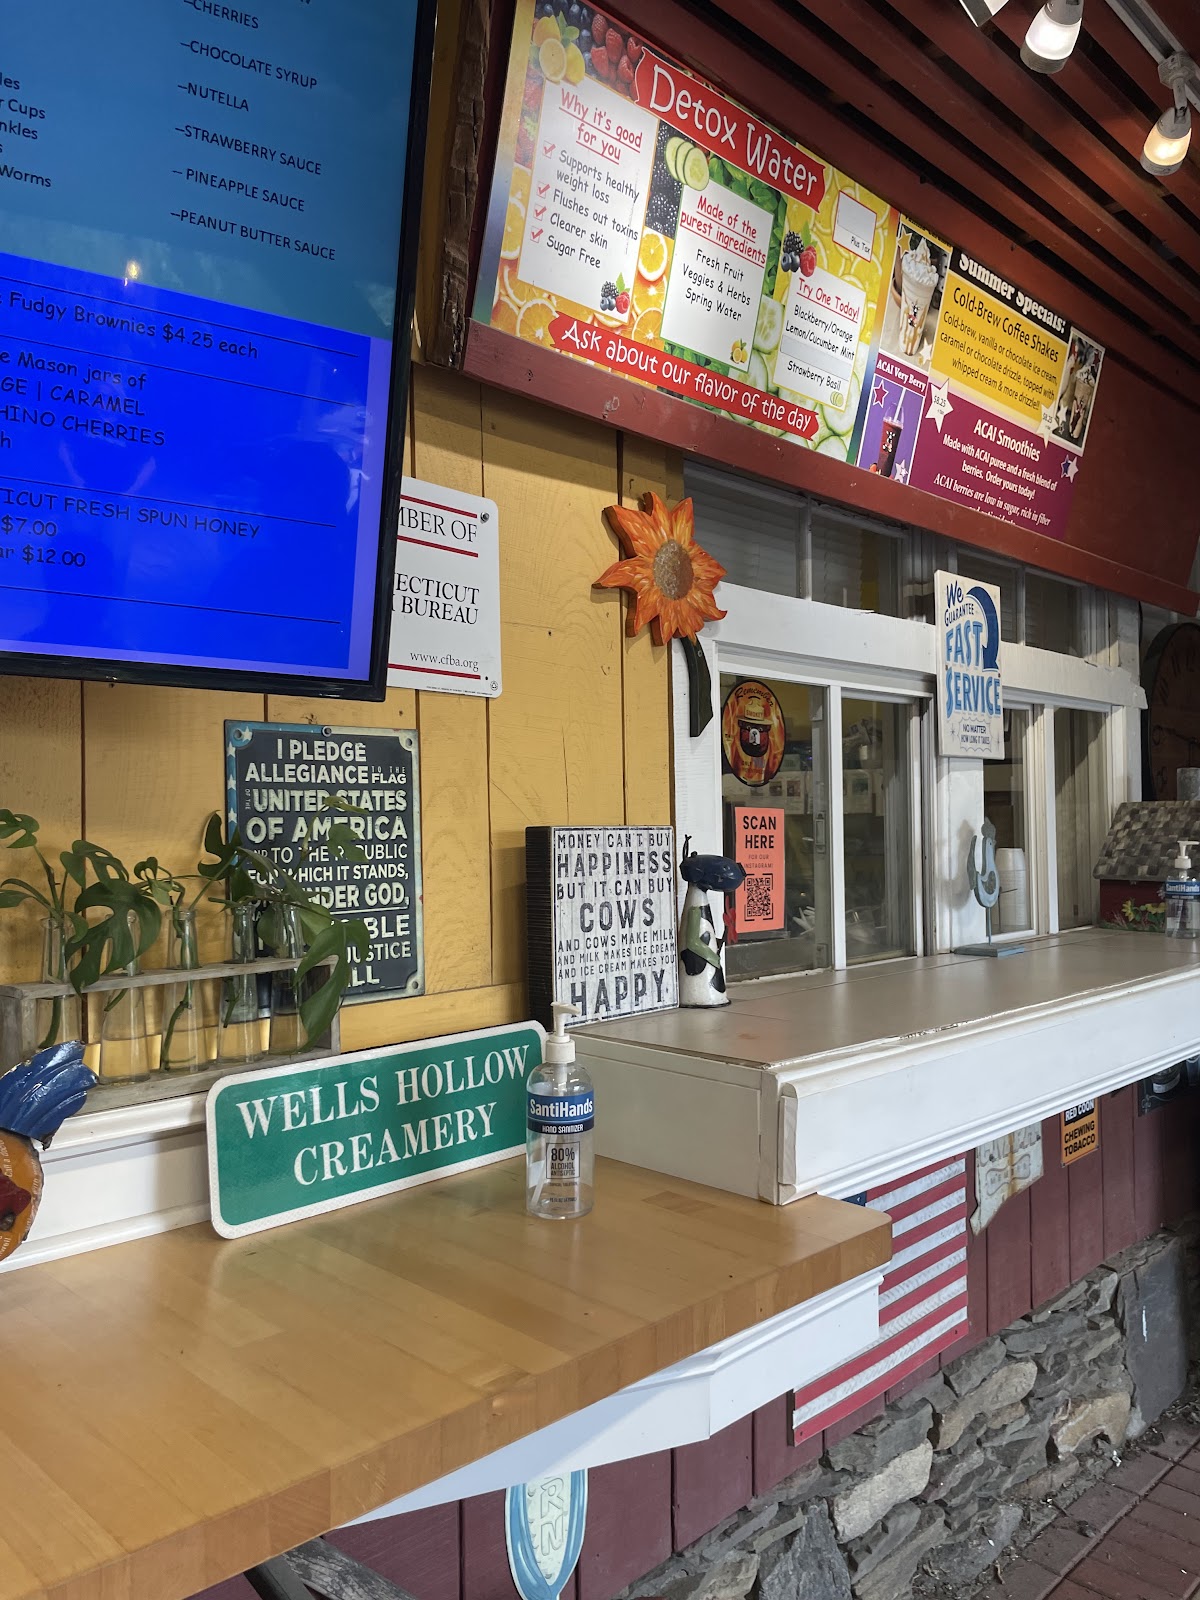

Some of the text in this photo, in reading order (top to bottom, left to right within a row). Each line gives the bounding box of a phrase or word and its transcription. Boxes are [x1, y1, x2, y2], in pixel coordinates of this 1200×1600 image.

[276, 67, 317, 89] SYRUP
[8, 99, 46, 120] Cups
[561, 88, 643, 149] Why it's good
[577, 123, 621, 160] for you
[649, 63, 817, 196] Detox Water
[280, 152, 322, 175] SAUCE
[559, 150, 639, 203] Supports healthy
[186, 168, 304, 212] PINEAPPLE SAUCE
[556, 169, 610, 204] weight loss
[553, 188, 638, 241] Flushes out toxins
[697, 195, 757, 240] Made the
[240, 225, 335, 260] BUTTER SAUCE
[550, 212, 608, 249] Clearer skin
[680, 210, 766, 265] purest ingredients
[546, 235, 601, 269] Sugar Free
[696, 248, 744, 282] Fresh Fruit
[682, 262, 751, 306] Veggies Herbs
[798, 277, 860, 320] Try One Today!
[685, 287, 742, 322] Spring Water
[9, 291, 258, 359] Fudgy Brownies $4.25 each
[794, 304, 853, 343] Blackberry/Orange
[953, 287, 1058, 363] Cold-Brew Coffee Shakes
[841, 344, 855, 361] Mint
[940, 331, 966, 353] caramel
[974, 349, 1002, 373] chocolate
[18, 352, 77, 376] Mason
[83, 364, 121, 385] jars
[128, 374, 147, 390] of
[561, 320, 812, 433] Ask about our flavor of the day
[787, 360, 825, 386] Strawberry
[876, 359, 926, 392] ACAI Very Berry
[952, 358, 978, 379] whipped
[50, 386, 145, 416] CARAMEL
[62, 415, 165, 446] CHERRIES
[973, 419, 1041, 462] ACAI Smoothies
[943, 433, 990, 463] Made ACAI
[933, 473, 953, 490] ACAI
[1, 514, 57, 536] $7.00
[64, 497, 260, 539] FRESH SPUN HONEY
[451, 520, 478, 542] OF
[22, 544, 86, 567] $12.00
[394, 572, 480, 605] ECTICUT
[946, 580, 964, 608] We
[401, 595, 479, 625] BUREAU
[944, 602, 975, 628] GUARANTEE
[945, 619, 984, 668] FAST
[410, 651, 479, 673] www.cfba.org
[945, 666, 1002, 719] SERVICE
[277, 738, 367, 762] I PLEDGE
[245, 762, 369, 784] ALLEGIANCE
[371, 773, 407, 784] FLAG
[252, 788, 408, 812] UNITED STATES
[246, 815, 408, 844] OF AMRICA
[743, 815, 777, 830] SCAN
[271, 846, 293, 864] TO
[557, 832, 671, 849] MONEY CAN'T BUY
[744, 834, 775, 849] HERE
[353, 863, 409, 880] STANDS,
[557, 851, 672, 878] HAPPINESS
[364, 882, 410, 907] GOD,
[556, 877, 673, 900] BUT IT CAN BUY
[579, 897, 655, 933] COWS
[557, 928, 674, 953] AND COWS MAKE MILK
[557, 941, 675, 966] AND MILK MAKES ICE CREAM
[558, 954, 676, 980] AND ICE CREAM MAKES YOU
[570, 968, 665, 1018] HAPPY
[236, 1044, 530, 1140] WELLS HOLLOW
[530, 1098, 593, 1118] SantiHands
[1065, 1107, 1078, 1122] RED
[542, 1123, 584, 1134] HAND SANITIZER
[1064, 1120, 1095, 1144] CHEWING
[294, 1101, 498, 1186] CREAMERY
[551, 1147, 575, 1162] 80%
[1064, 1133, 1096, 1157] TOBACCO
[551, 1162, 575, 1170] ALCOHOL
